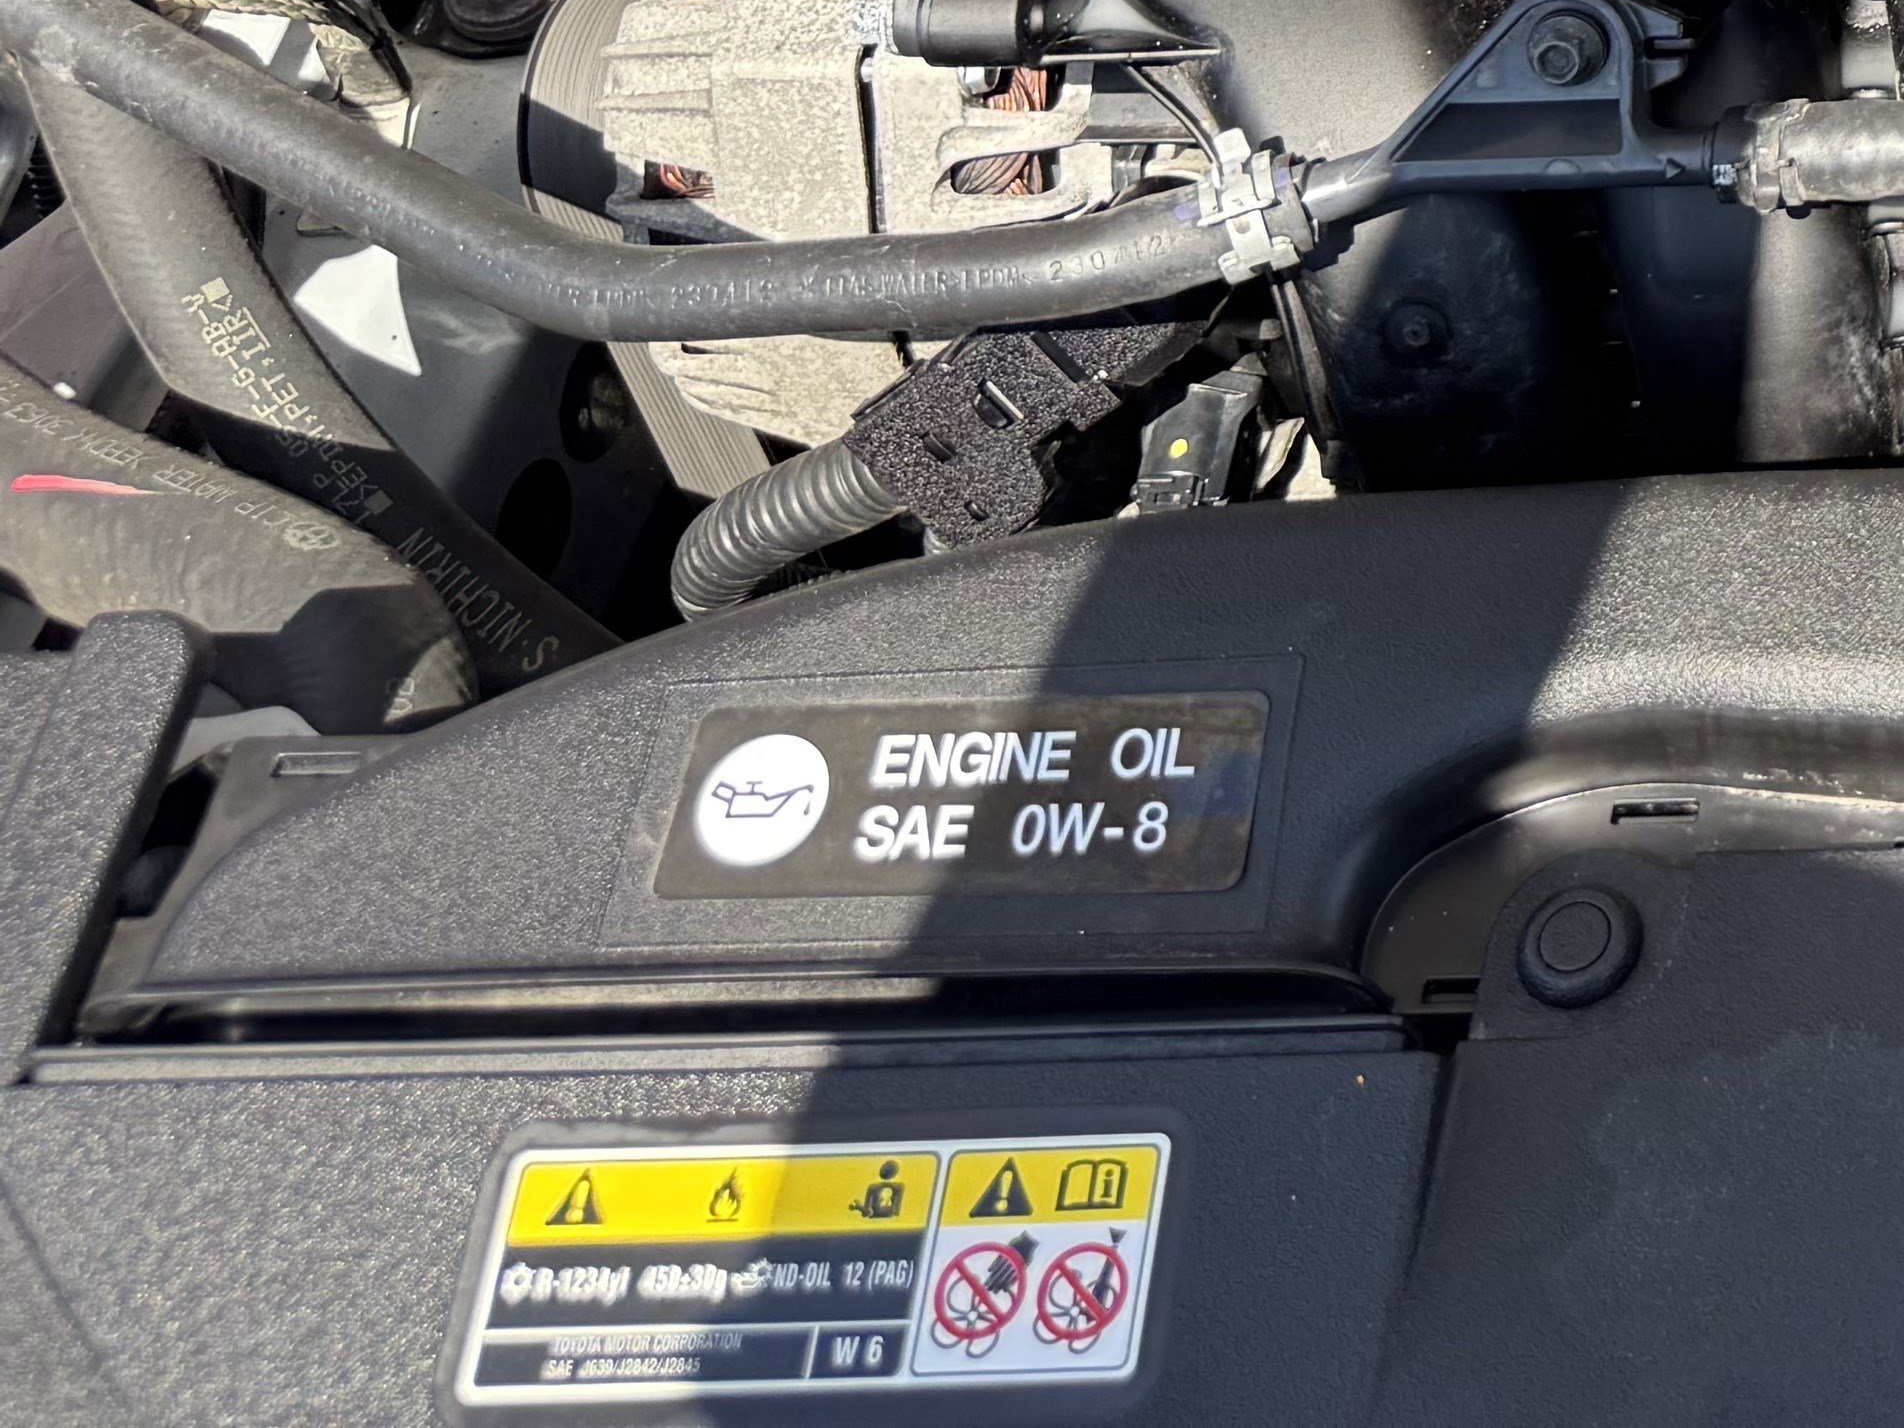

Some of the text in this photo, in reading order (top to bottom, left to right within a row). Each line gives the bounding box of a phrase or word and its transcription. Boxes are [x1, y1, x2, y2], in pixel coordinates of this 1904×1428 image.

[153, 463, 236, 513] WATER
[870, 726, 1197, 790] ENGINE OIL
[853, 800, 1170, 862] SAE 0W-8
[774, 1261, 831, 1289] ND-OIL
[842, 1262, 862, 1285] 12
[868, 1258, 915, 1289] (PAG)
[552, 1332, 742, 1355] TOYOTA MOTOR CORPORATION
[833, 1334, 885, 1368] W 6
[545, 1360, 574, 1379] SAE
